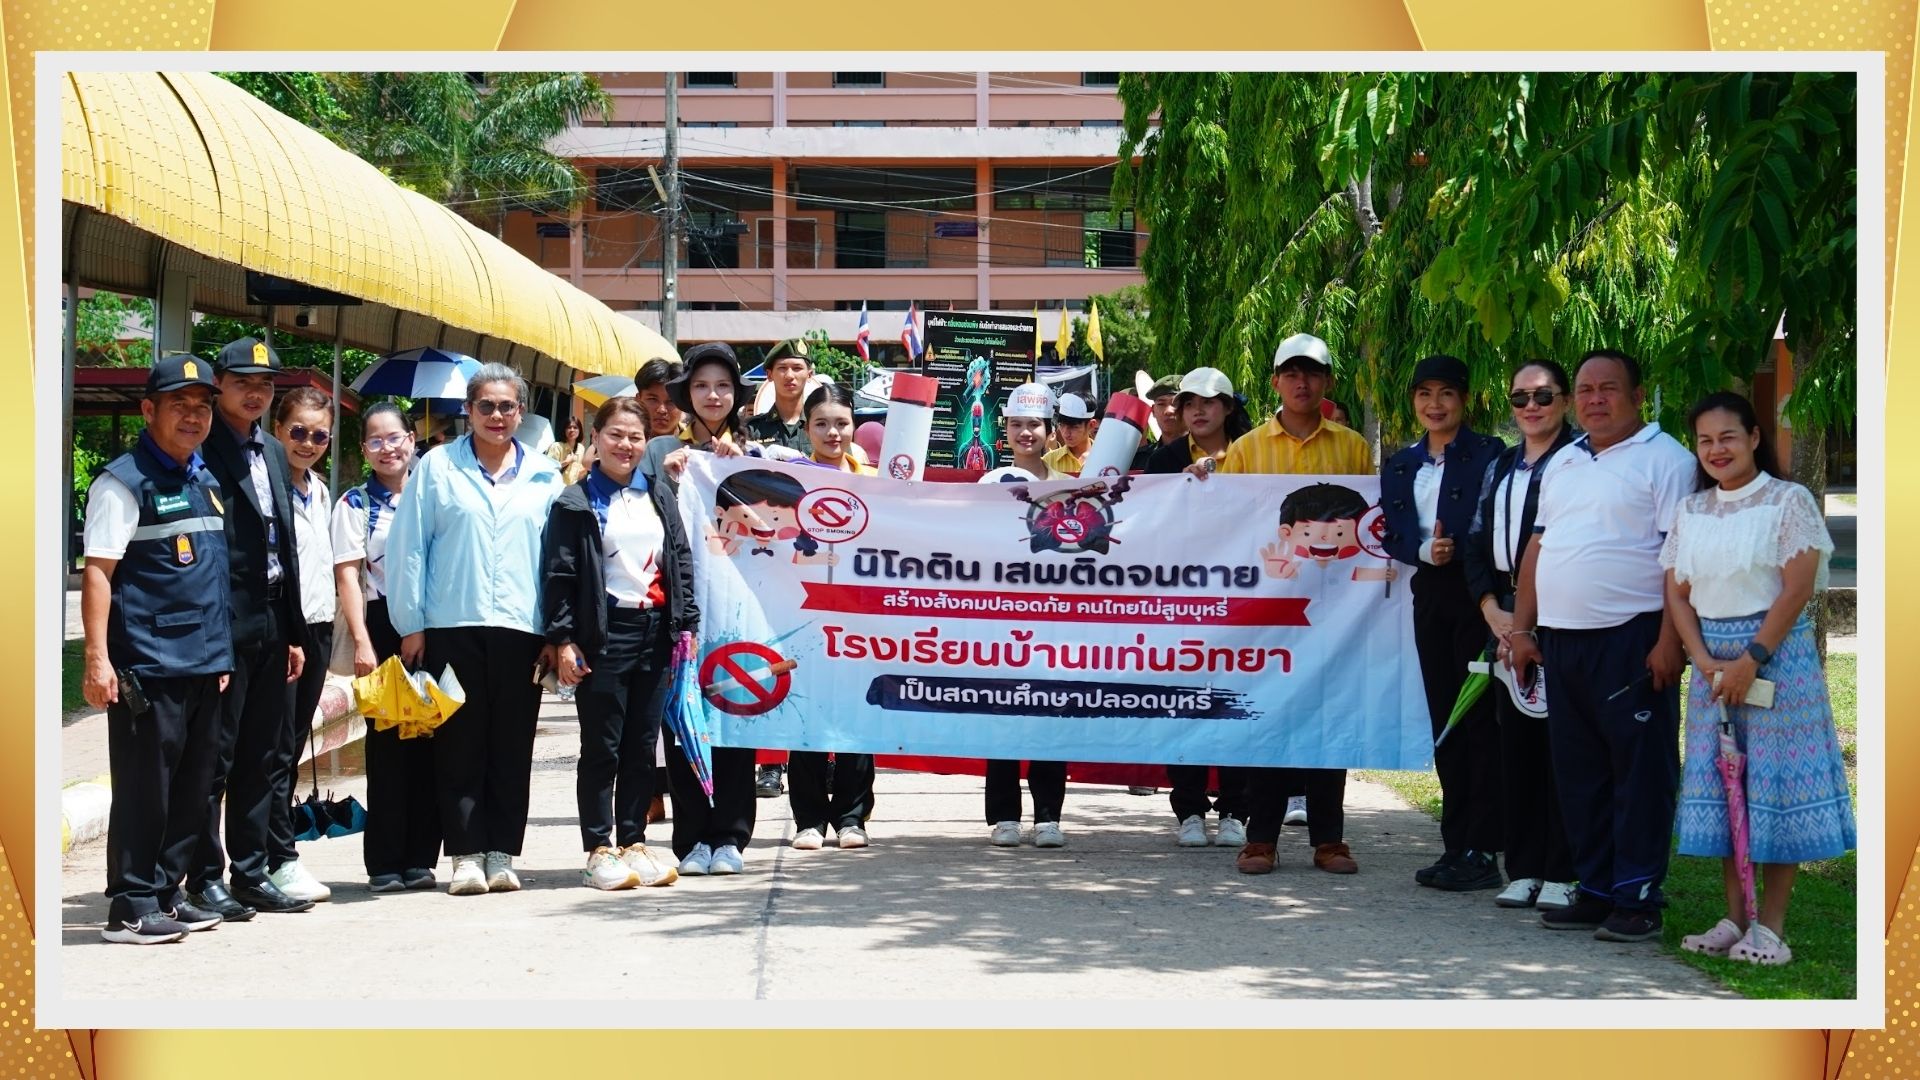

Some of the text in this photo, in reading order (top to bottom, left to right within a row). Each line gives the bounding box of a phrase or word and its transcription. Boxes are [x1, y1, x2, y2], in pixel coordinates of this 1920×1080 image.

[853, 547, 1260, 588] นิโคติน เสพติดจนตาย
[882, 589, 1229, 622] สร้างสังคมปลอดภัย คนไทยไม่สูบบุหรี่
[822, 625, 1292, 673] โรงเรียนบ้านแท่นวิทยา
[899, 677, 1212, 717] เป็นสถานศึกษาปลอดบุหรี่
